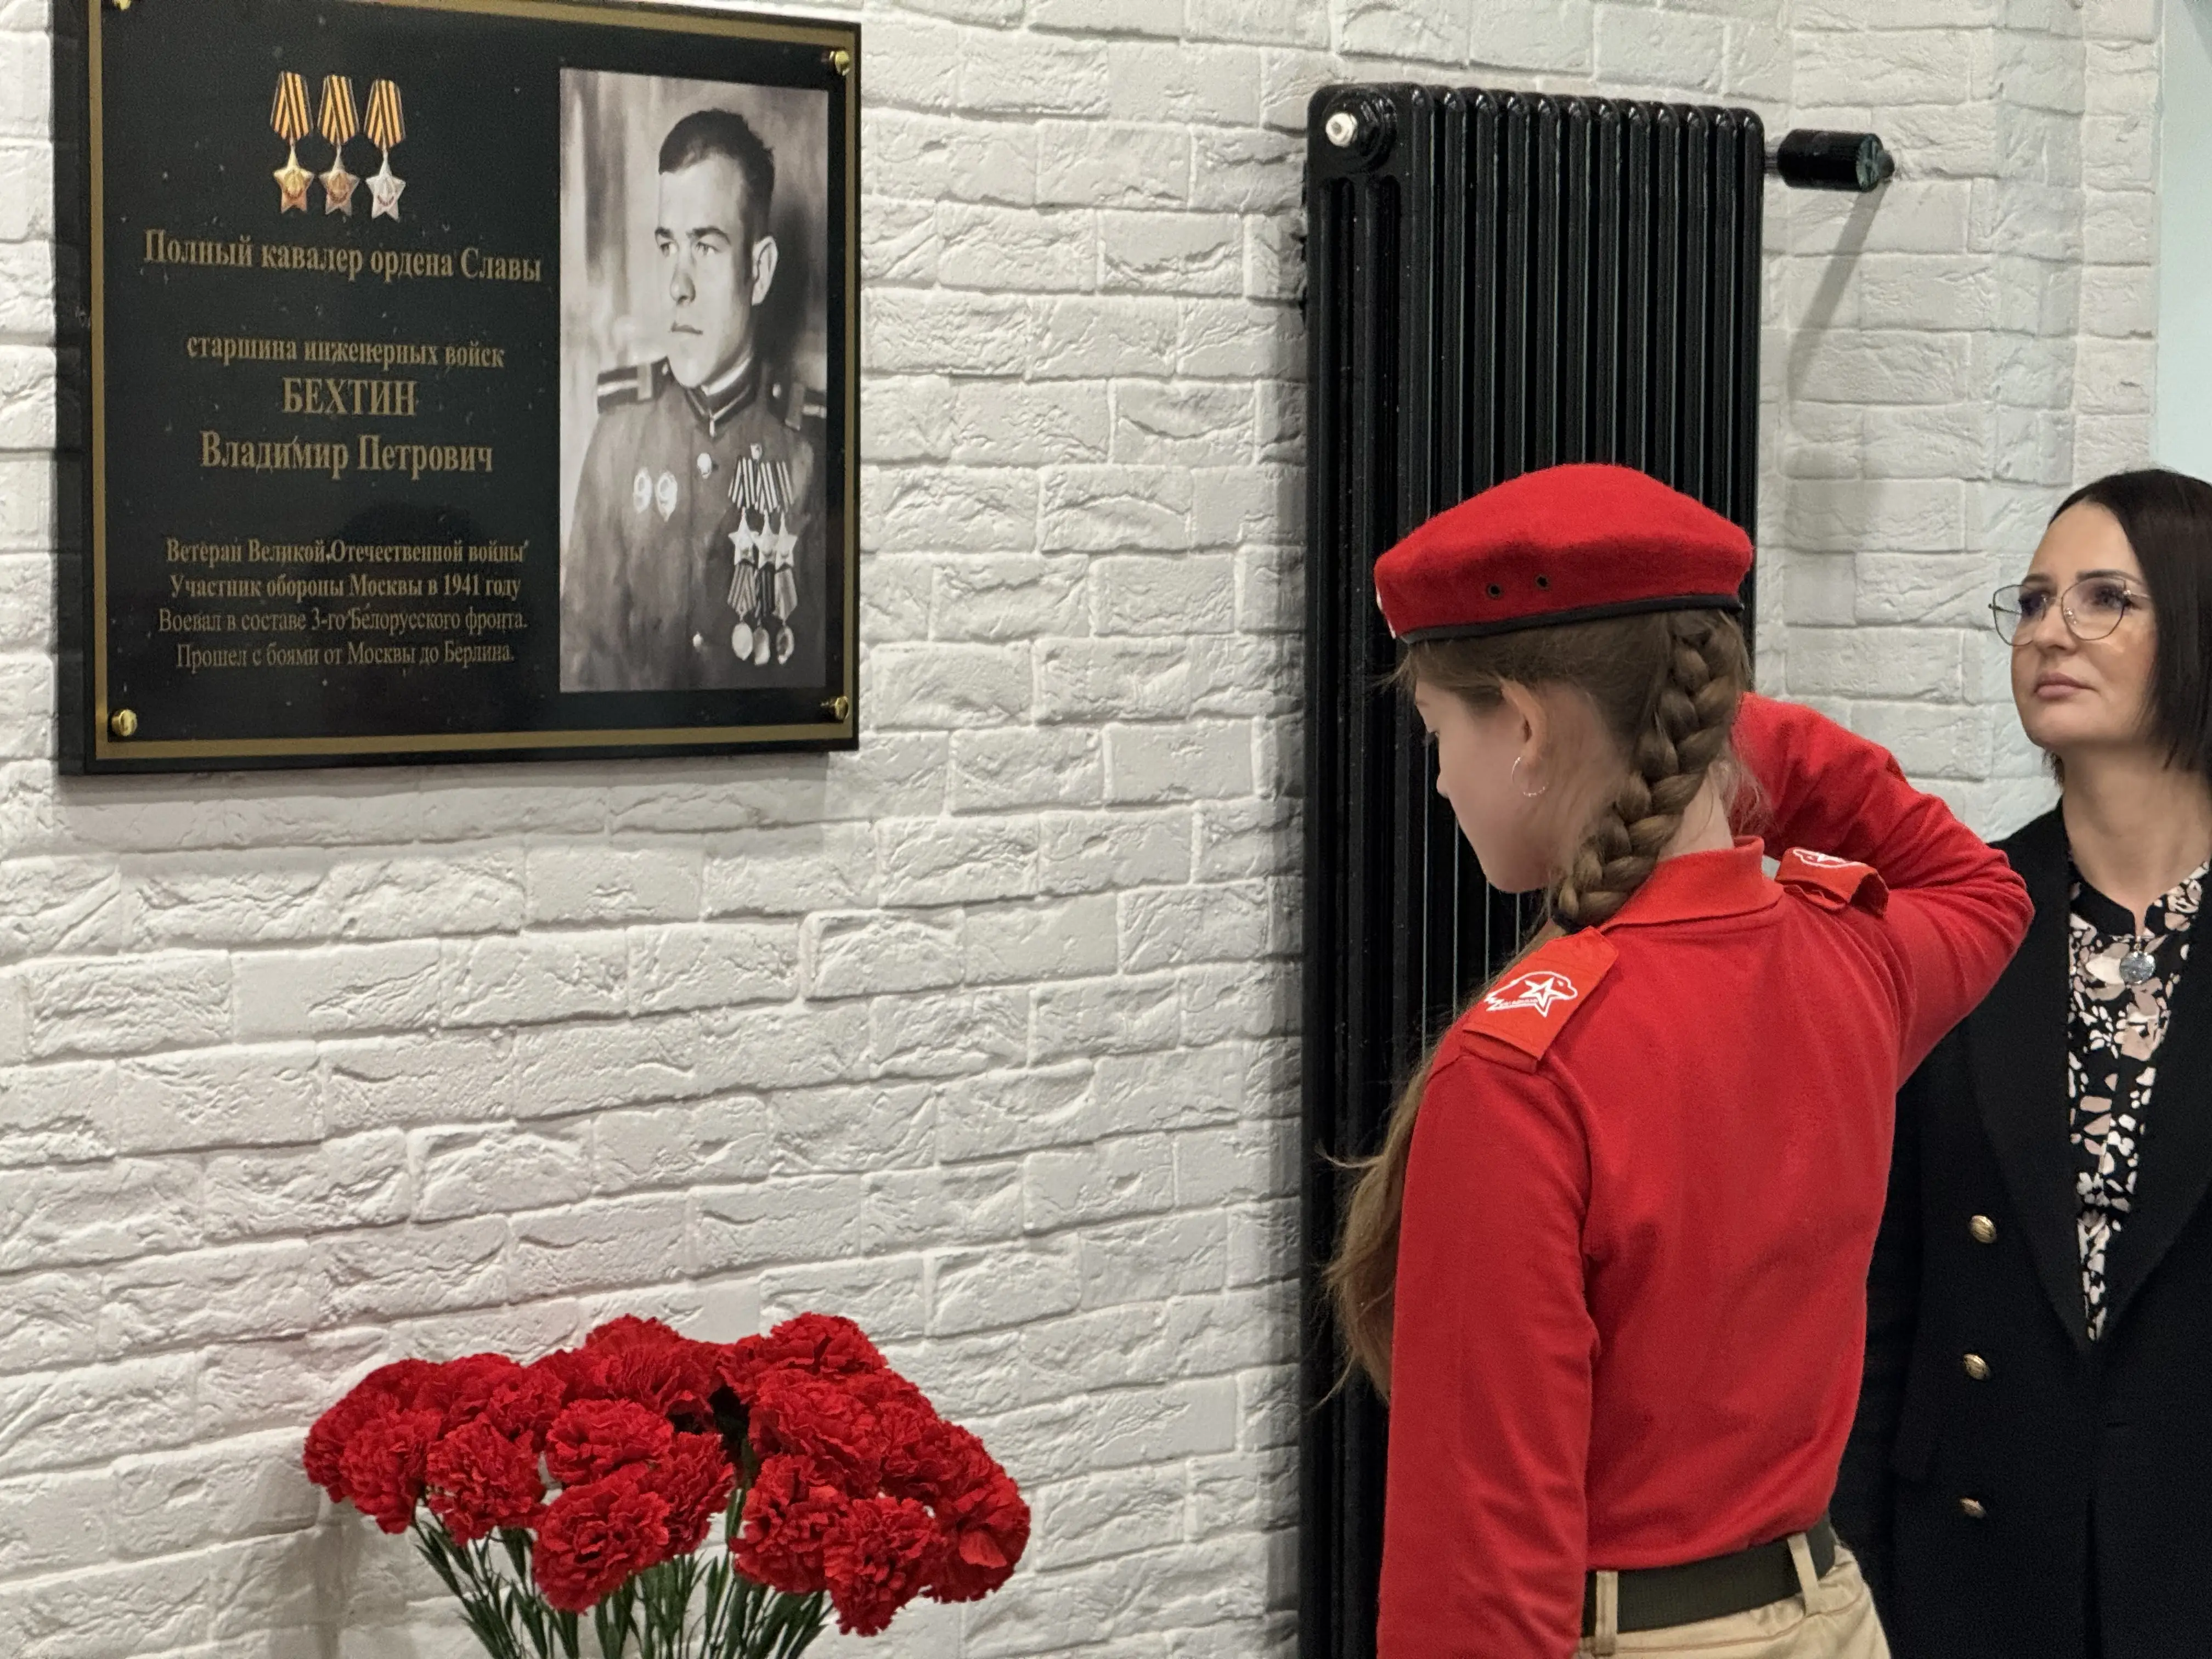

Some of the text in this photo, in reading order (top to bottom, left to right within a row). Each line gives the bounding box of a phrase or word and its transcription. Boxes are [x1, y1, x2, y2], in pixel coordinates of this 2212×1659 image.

[144, 229, 542, 283] Полный кавалер ордена Славы
[186, 334, 505, 371] старшина инженерных войск
[281, 376, 418, 417] БЕХТИН
[200, 430, 493, 481] Владимир Петрович
[166, 537, 524, 569] Ветеран Великой Отечественной войны
[170, 573, 521, 603] Участник обороны Москвы в 1941 году
[159, 606, 528, 636] Воевал в составе 3-го Белорусского фронта.
[176, 640, 515, 674] Прошел с боями от Москвы до Берлина.
